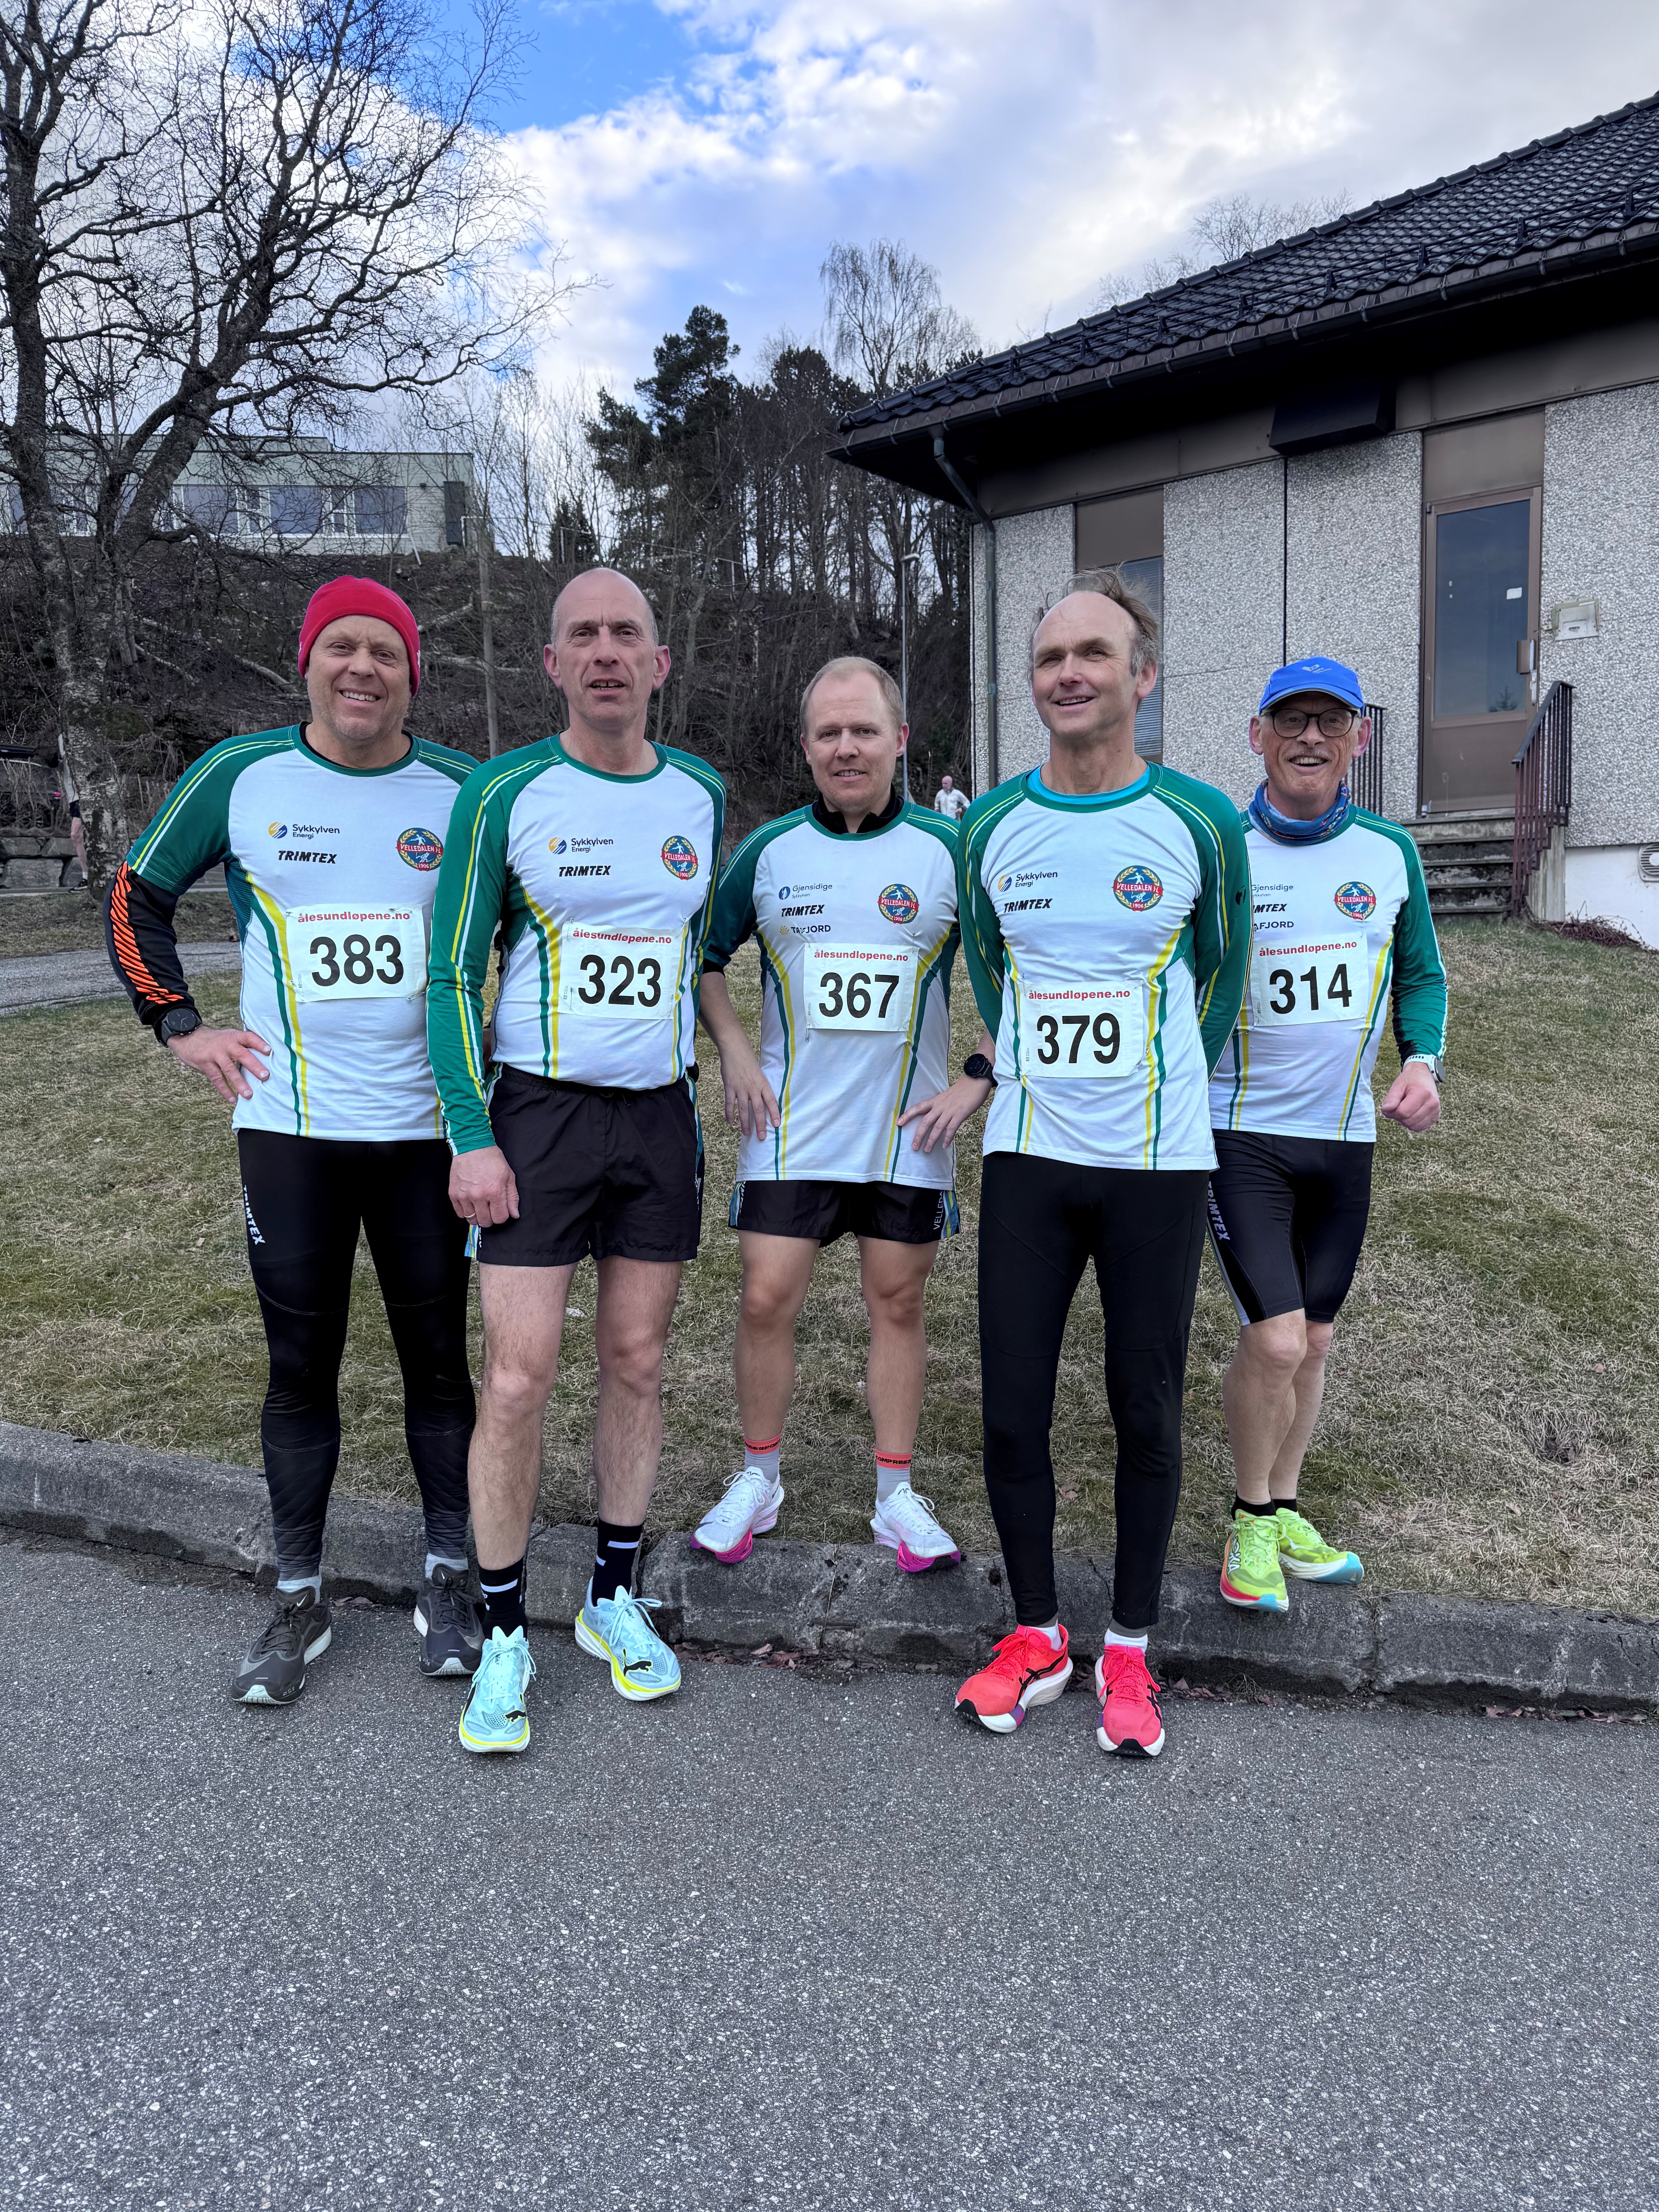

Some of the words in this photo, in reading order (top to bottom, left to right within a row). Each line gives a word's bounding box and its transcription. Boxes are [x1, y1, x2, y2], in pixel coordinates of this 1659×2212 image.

[292, 824, 340, 833] Sykkylven
[400, 843, 434, 852] VELLEDALEN
[571, 838, 613, 847] Sykkylven
[278, 850, 337, 864] TRIMTEX
[664, 852, 691, 862] VELLEDALEN
[559, 865, 611, 877] TRIMTEX
[1016, 871, 1058, 882] Sykkylven
[792, 883, 833, 893] Gjensidige
[1116, 883, 1152, 891] VELLEDALEN
[1252, 884, 1294, 892] Gjensidige
[881, 898, 910, 907] VELLEDALEN
[1004, 898, 1053, 913] TRIMTEX
[781, 904, 825, 917] TRIMTEX
[297, 911, 410, 923] ålesundløpene.no
[572, 927, 672, 944] ålesundløpene.no
[814, 949, 908, 962] ålesundløpene.no
[1259, 942, 1357, 957] ålesundløpene.no
[310, 934, 404, 987] 383
[578, 954, 661, 1007] 323
[1269, 963, 1352, 1014] 314
[819, 972, 900, 1018] 367
[1029, 989, 1130, 1001] ålesundløpene.no
[1037, 1012, 1120, 1065] 379
